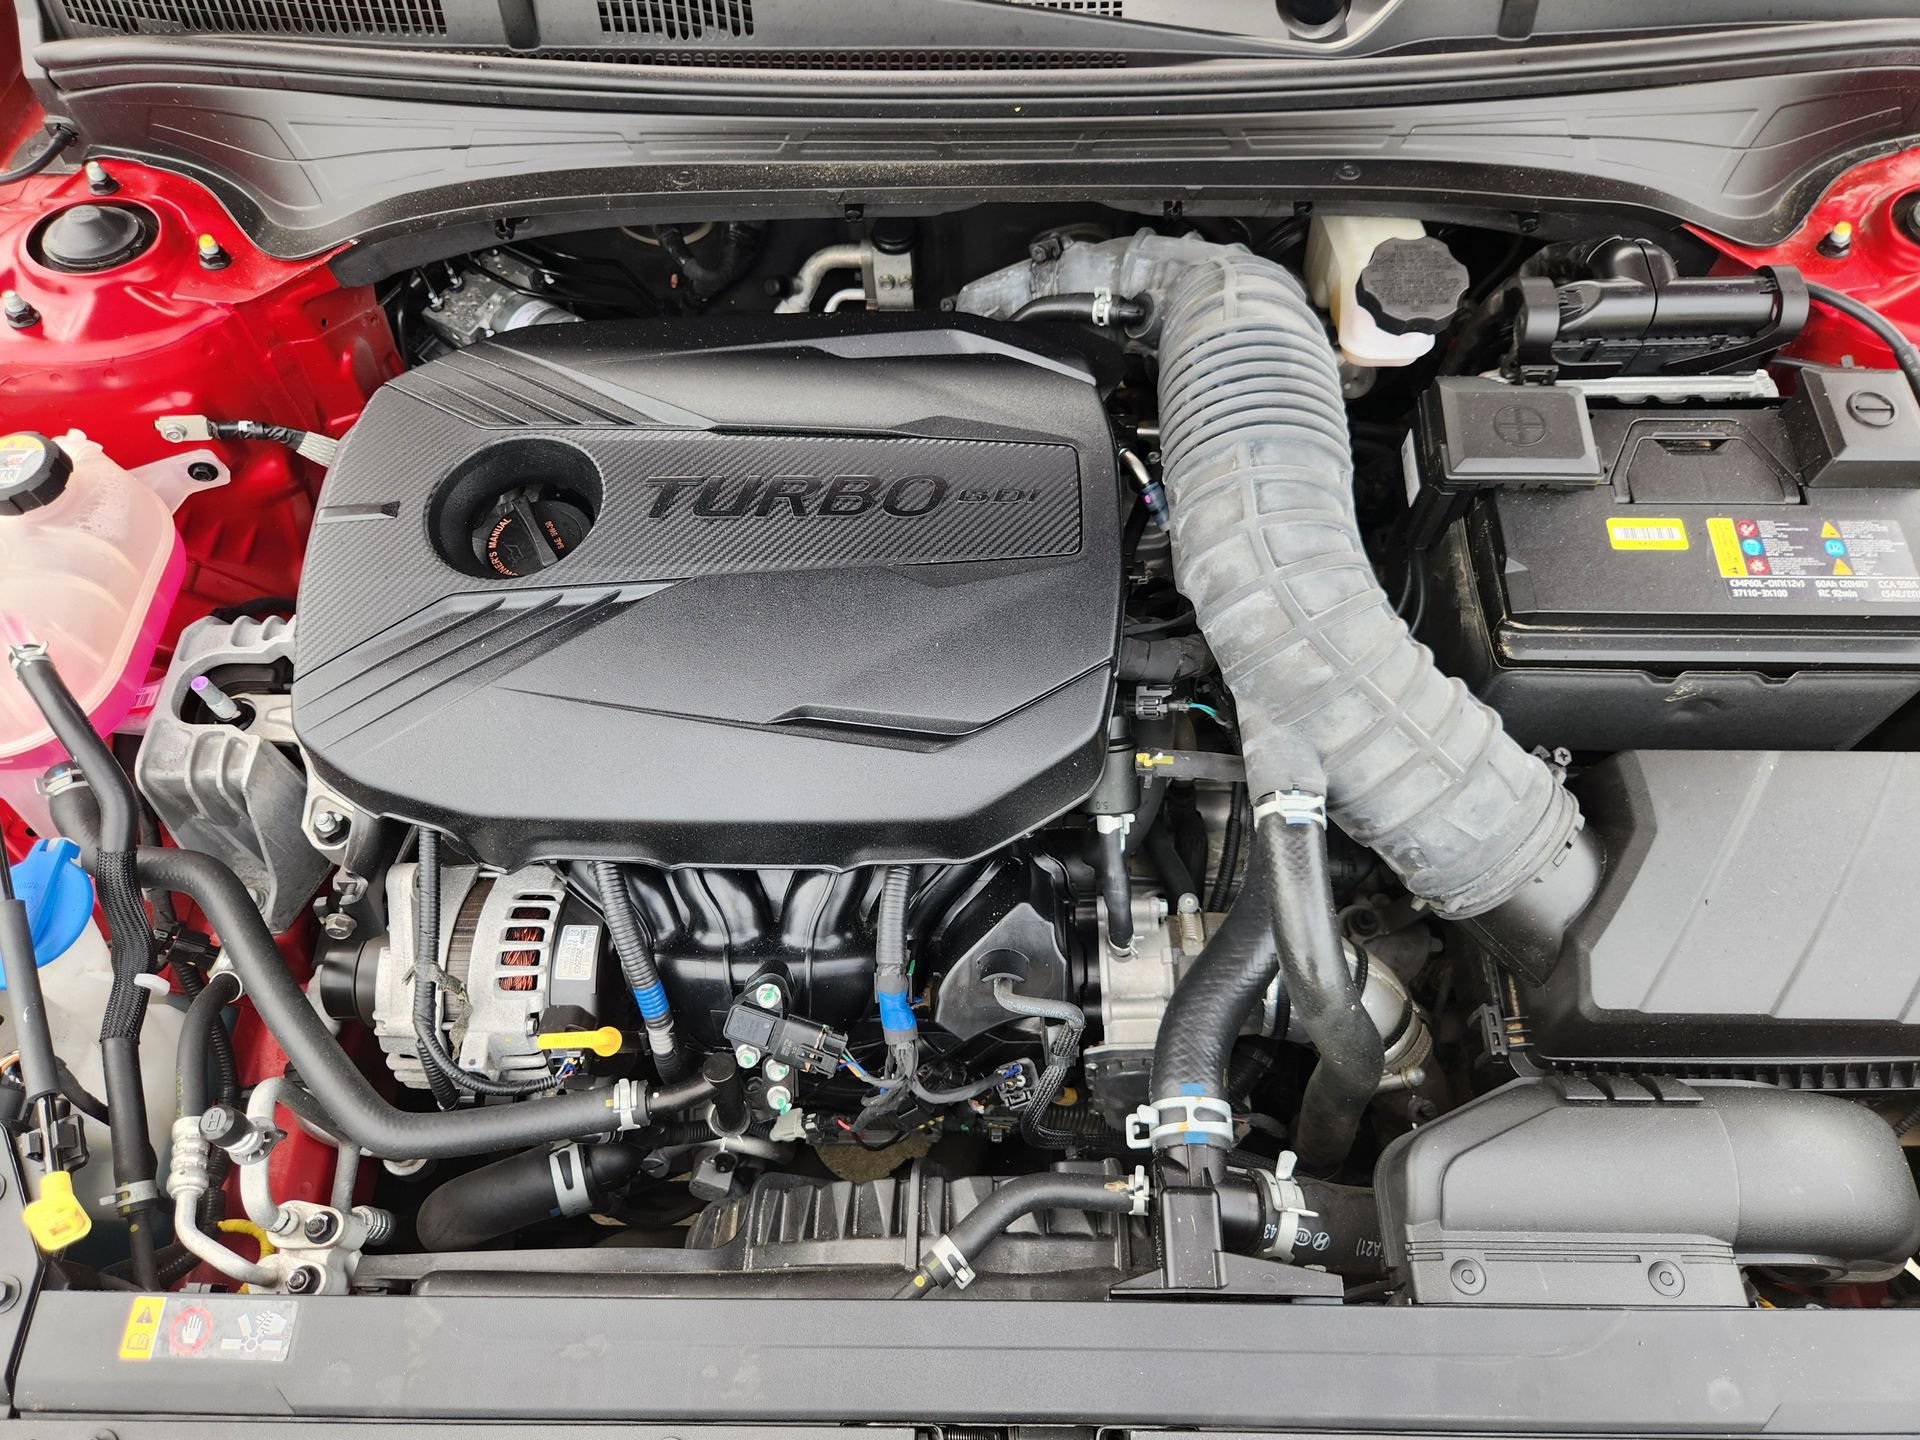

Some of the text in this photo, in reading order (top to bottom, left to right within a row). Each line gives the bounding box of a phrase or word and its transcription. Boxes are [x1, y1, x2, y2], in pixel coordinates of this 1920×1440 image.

[645, 474, 1038, 518] TURBO GDI
[488, 517, 513, 549] MANUAL
[553, 537, 565, 550] SAE
[1878, 580, 1897, 589] CCA
[1818, 589, 1831, 598] RC
[1263, 1223, 1278, 1239] 43
